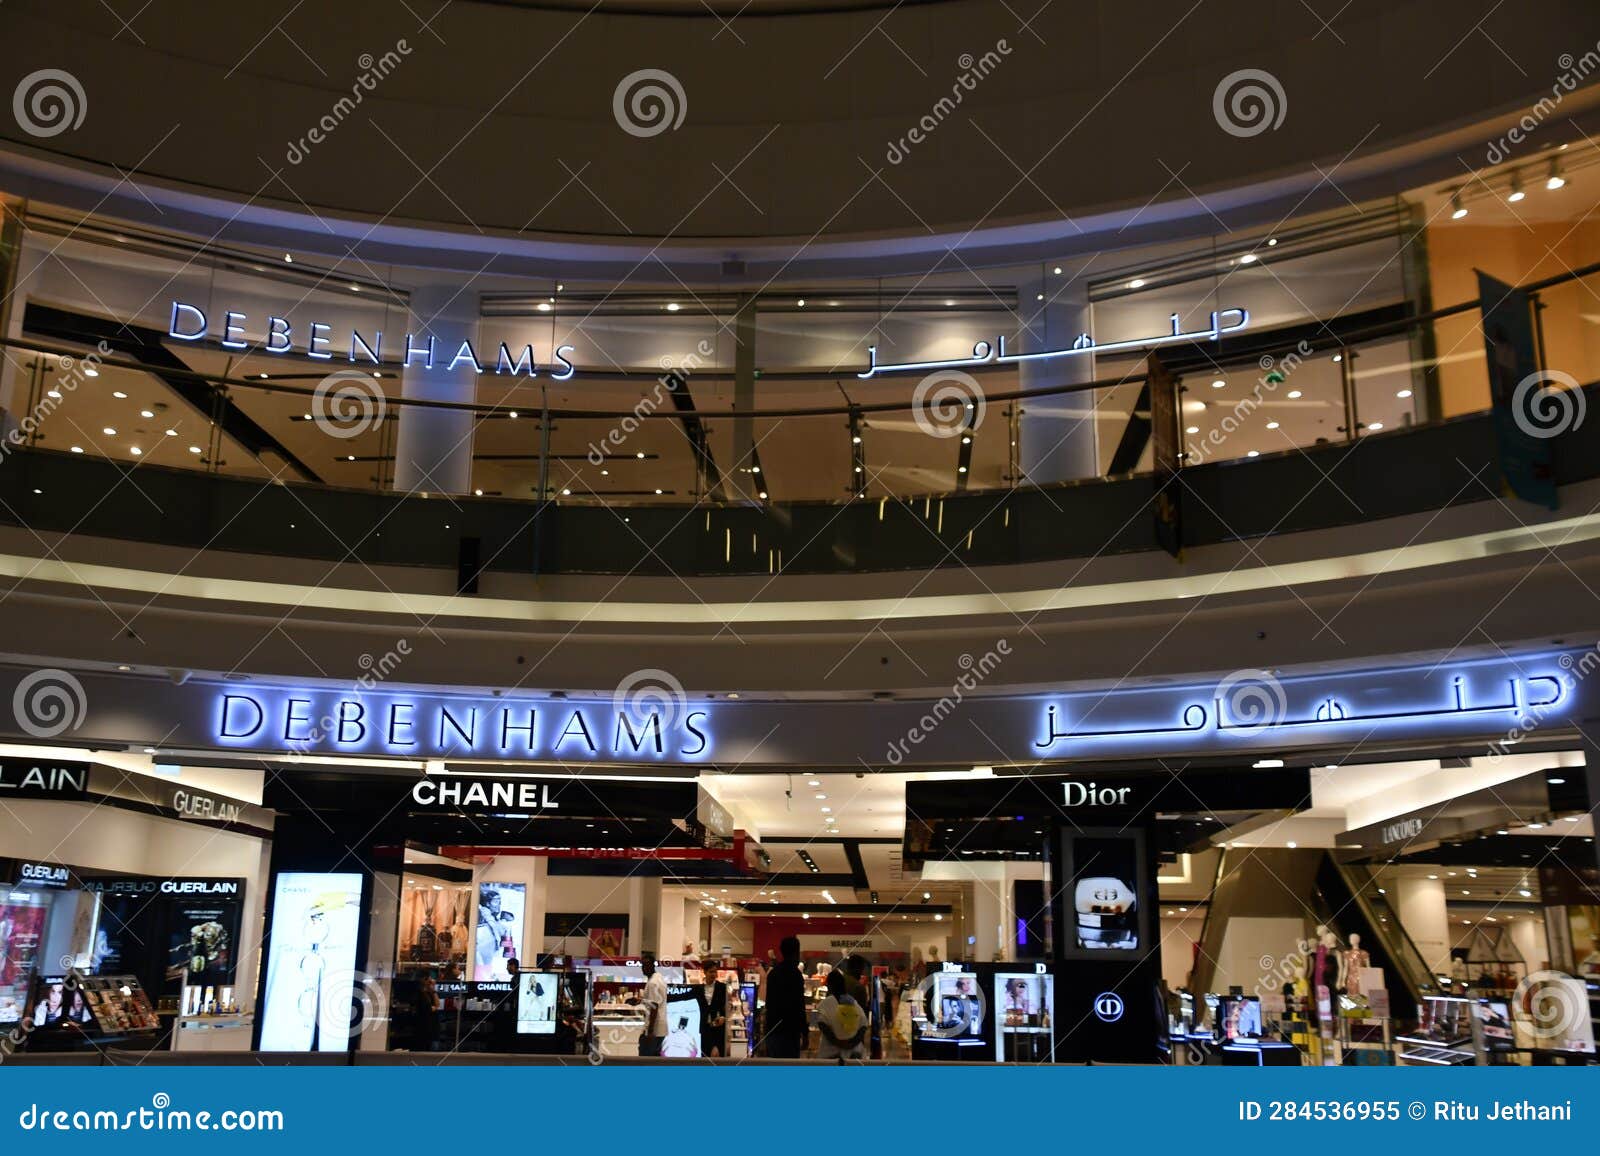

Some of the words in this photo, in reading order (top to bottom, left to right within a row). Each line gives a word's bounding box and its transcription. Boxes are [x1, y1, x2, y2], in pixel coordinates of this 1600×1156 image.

[169, 301, 576, 380] DEBENHAMS
[219, 694, 710, 755] DEBENHAMS
[173, 790, 239, 824] GUERLAIN
[412, 781, 559, 808] CHANEL
[1061, 782, 1131, 807] Dior
[22, 863, 69, 881] GUERLAIN
[160, 881, 237, 894] GUERLAIN
[942, 962, 963, 973] Dior
[477, 983, 512, 991] CHANEL
